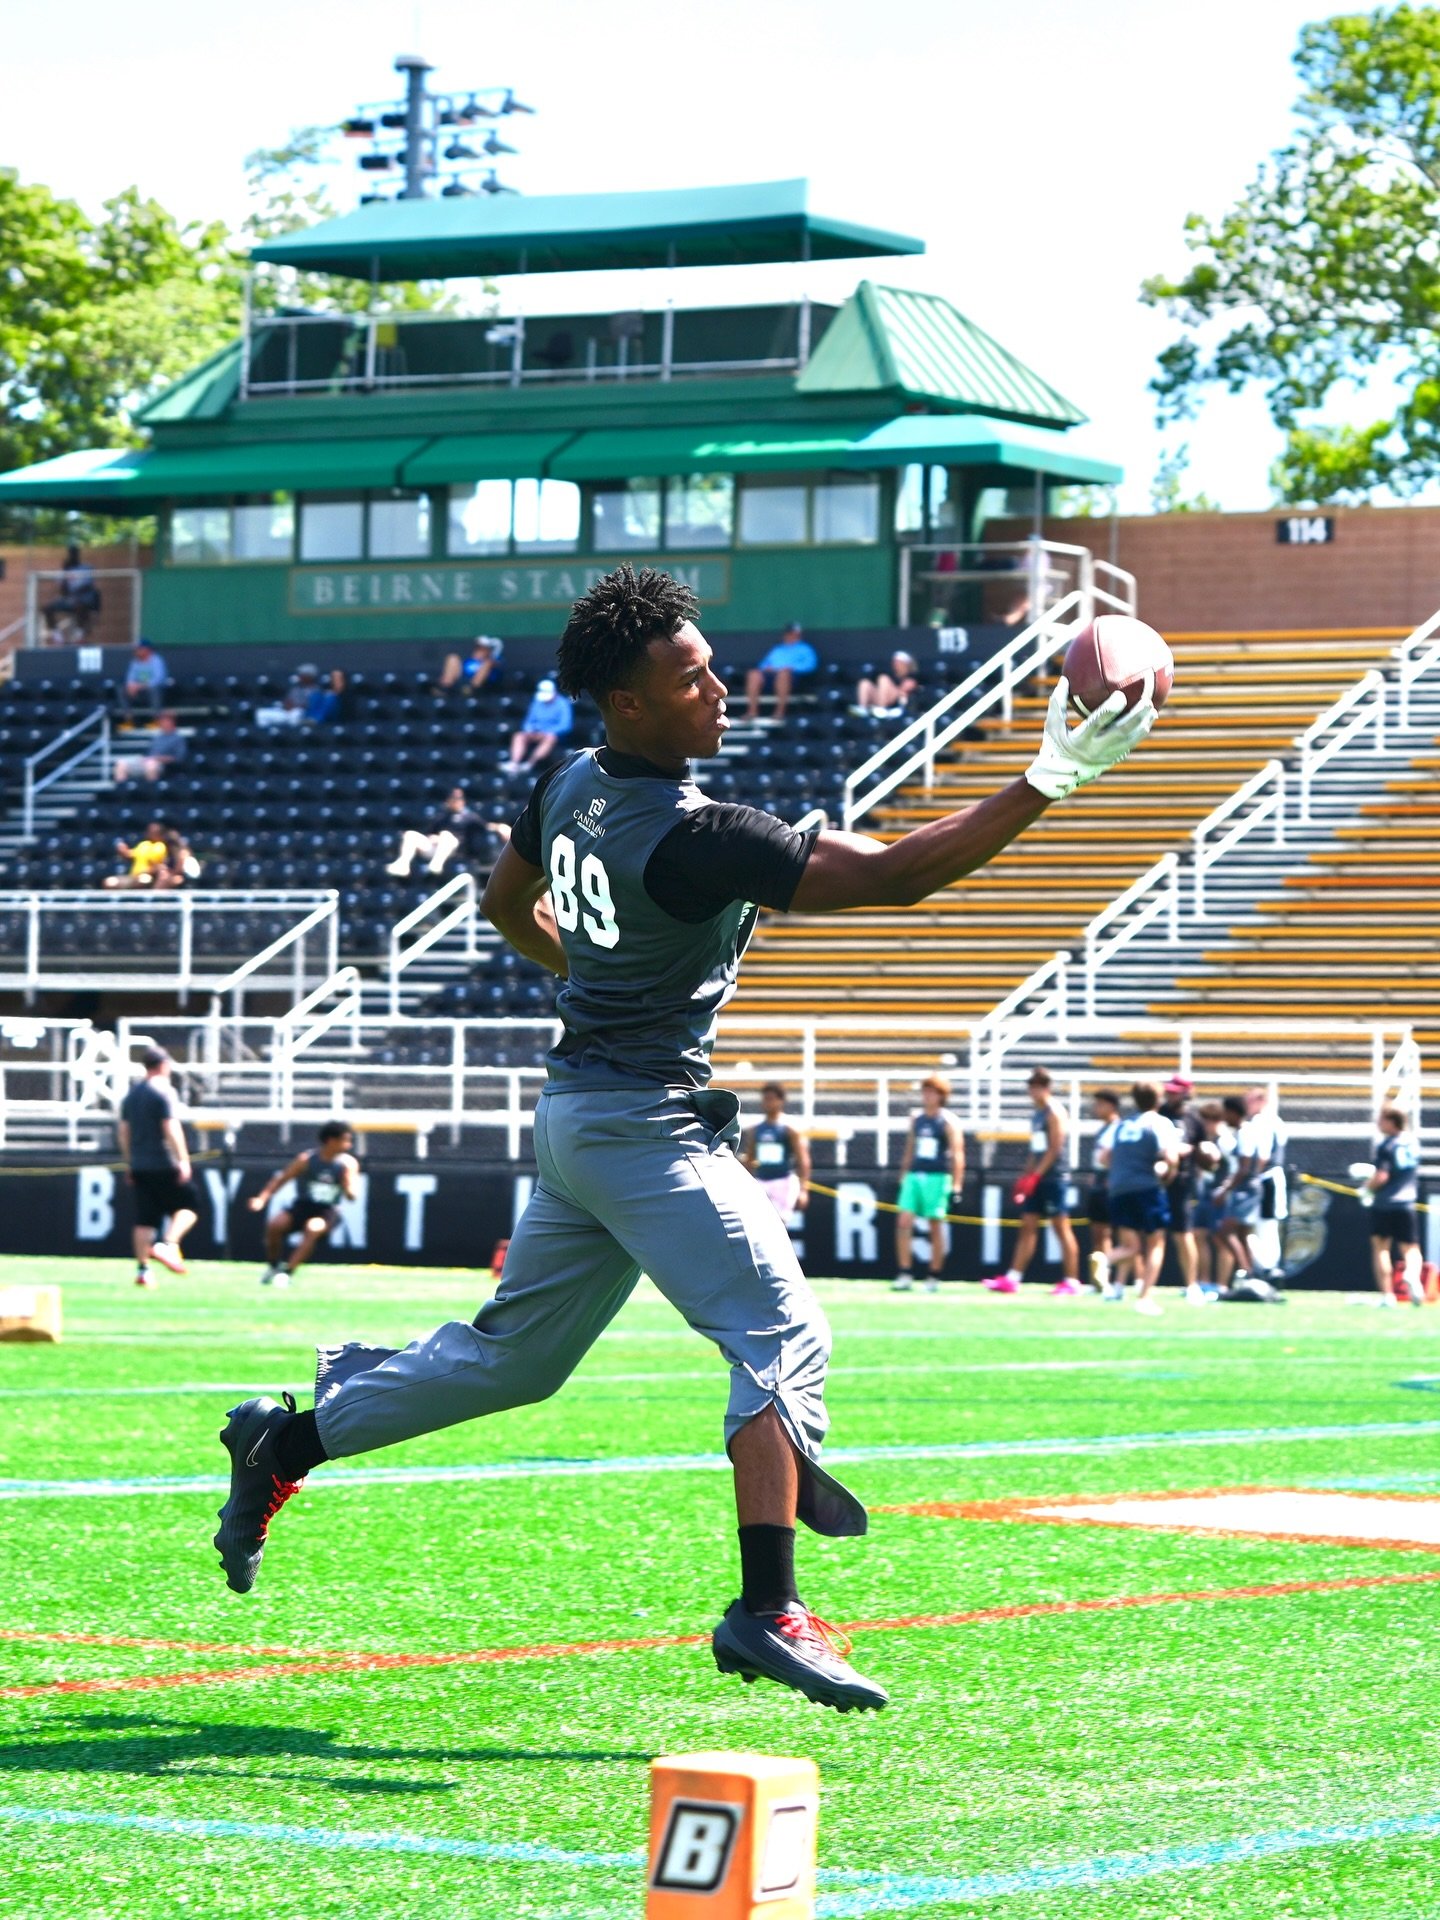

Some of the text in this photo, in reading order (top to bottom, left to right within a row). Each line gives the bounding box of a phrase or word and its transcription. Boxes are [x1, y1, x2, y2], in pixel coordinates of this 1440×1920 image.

[1288, 517, 1327, 543] 114
[313, 566, 700, 605] BEIRNE STADM
[938, 627, 968, 652] 113
[550, 833, 620, 949] 89
[75, 1165, 438, 1250] BYNT
[655, 1802, 737, 1892] B
